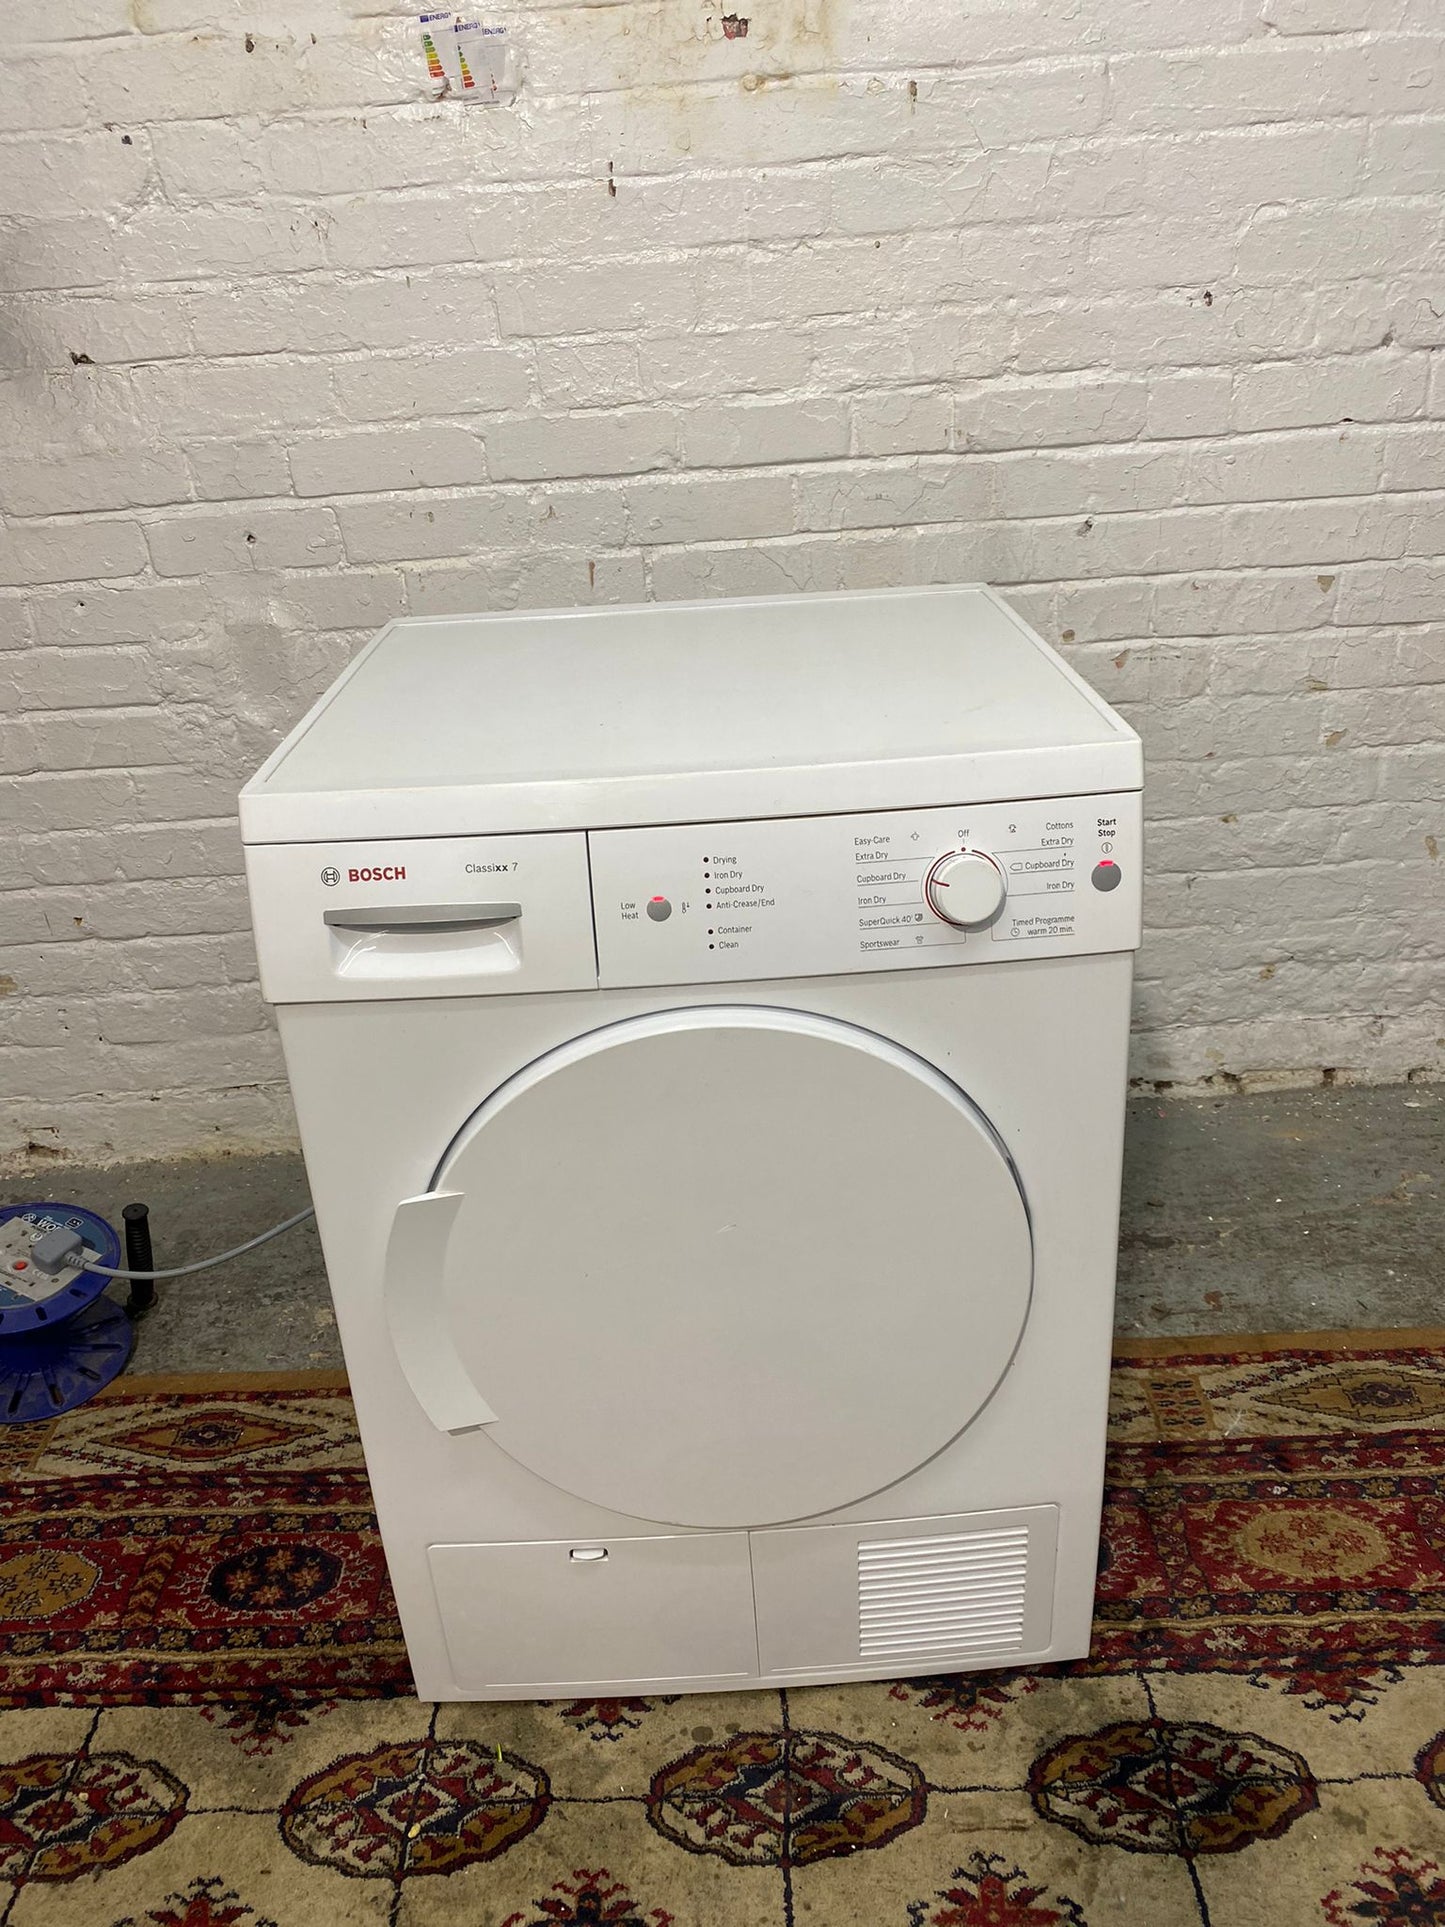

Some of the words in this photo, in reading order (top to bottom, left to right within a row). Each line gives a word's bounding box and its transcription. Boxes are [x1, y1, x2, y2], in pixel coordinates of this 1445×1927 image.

[1045, 822, 1074, 831] Cottons
[1097, 818, 1117, 827] Start
[957, 829, 970, 838] Off
[1098, 829, 1116, 838] Stop
[854, 835, 891, 846] Easy-Care
[1041, 838, 1060, 846] Extra
[1061, 836, 1074, 846] Dry
[713, 856, 737, 865] Drying
[855, 852, 874, 861] Extra
[875, 851, 889, 860] Dry
[465, 863, 509, 874] Classixx
[512, 862, 519, 872] 7
[1025, 861, 1060, 871] Cupboard
[1061, 859, 1075, 868] Dry
[348, 866, 406, 882] BOSCH
[714, 871, 728, 880] Iron
[730, 870, 743, 880] Dry
[856, 873, 892, 883] Cupboard
[893, 872, 907, 881] Dry
[715, 885, 750, 895] Cupboard
[751, 884, 765, 893] Dry
[1046, 882, 1060, 890] Iron
[1061, 880, 1075, 890] Dry
[716, 899, 775, 910] Anti-Crease/End
[858, 897, 872, 905] Iron
[873, 895, 887, 904] Dry
[620, 902, 636, 910] Low
[621, 911, 639, 920] Heat
[859, 916, 900, 927] SuperQuick
[1012, 918, 1034, 927] Timed
[1035, 915, 1075, 925] Programme
[717, 926, 752, 935] Container
[1027, 927, 1047, 935] warm
[1048, 926, 1059, 934] 20
[718, 941, 739, 949] Clean
[860, 939, 900, 950] Sportswear
